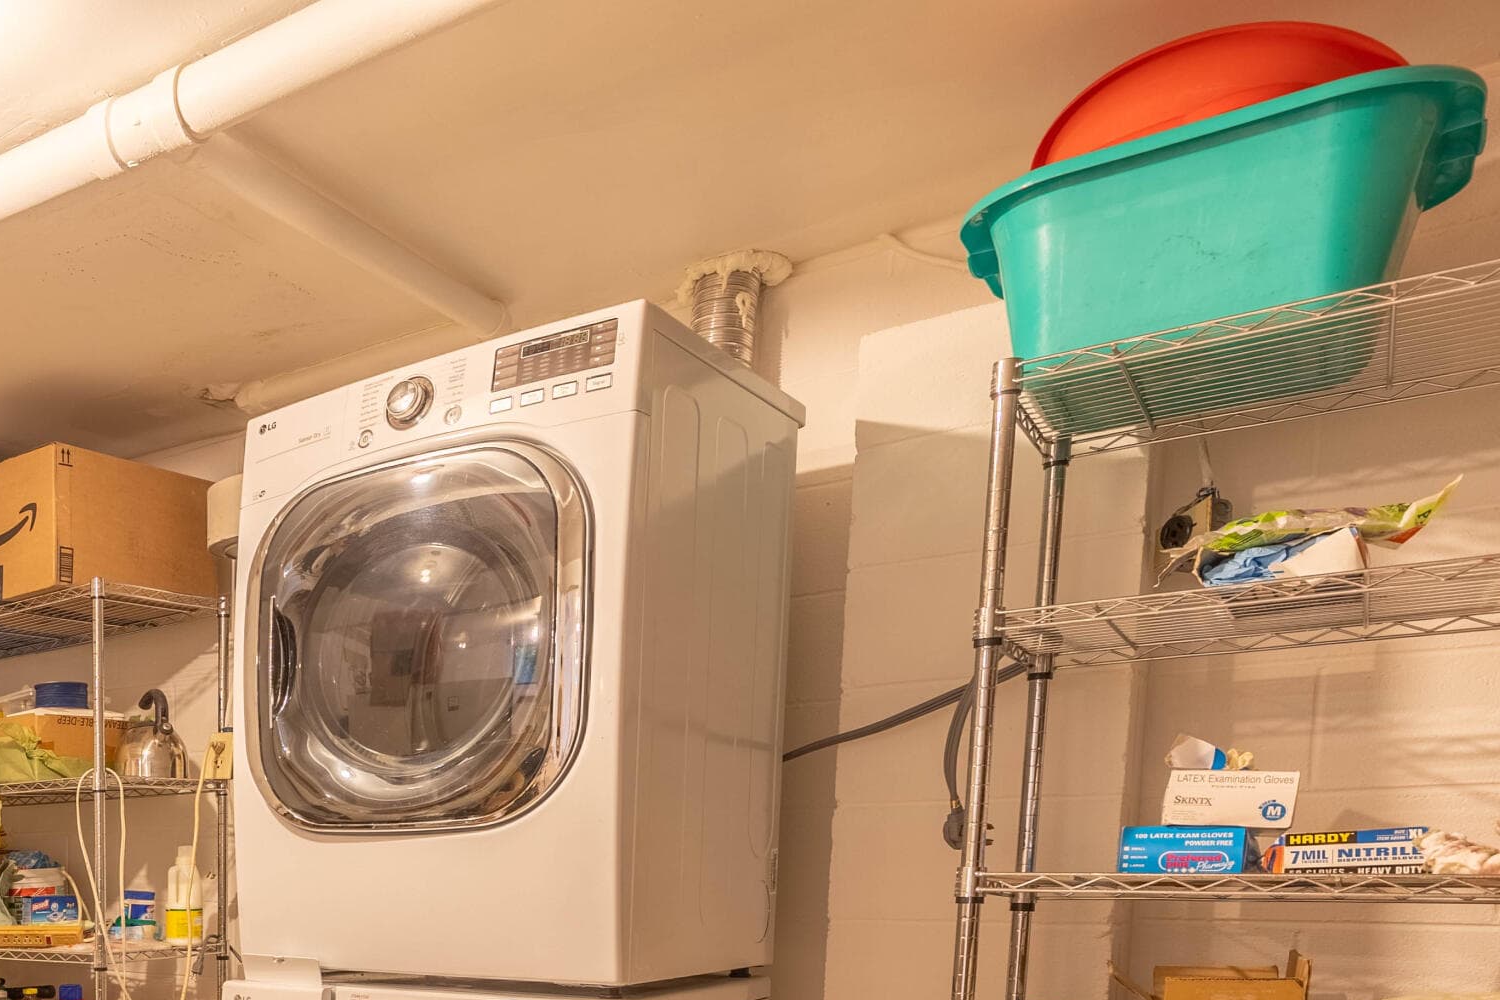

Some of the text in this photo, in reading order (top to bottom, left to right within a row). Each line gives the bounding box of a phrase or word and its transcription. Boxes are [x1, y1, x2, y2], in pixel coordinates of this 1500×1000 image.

[1177, 774, 1294, 784] LATEX Examination Gloves
[1266, 806, 1282, 816] M
[1289, 832, 1350, 845] HARDY
[1166, 853, 1223, 862] Preferred
[1290, 850, 1328, 864] 7 MIL
[1396, 866, 1422, 874] DUTY
